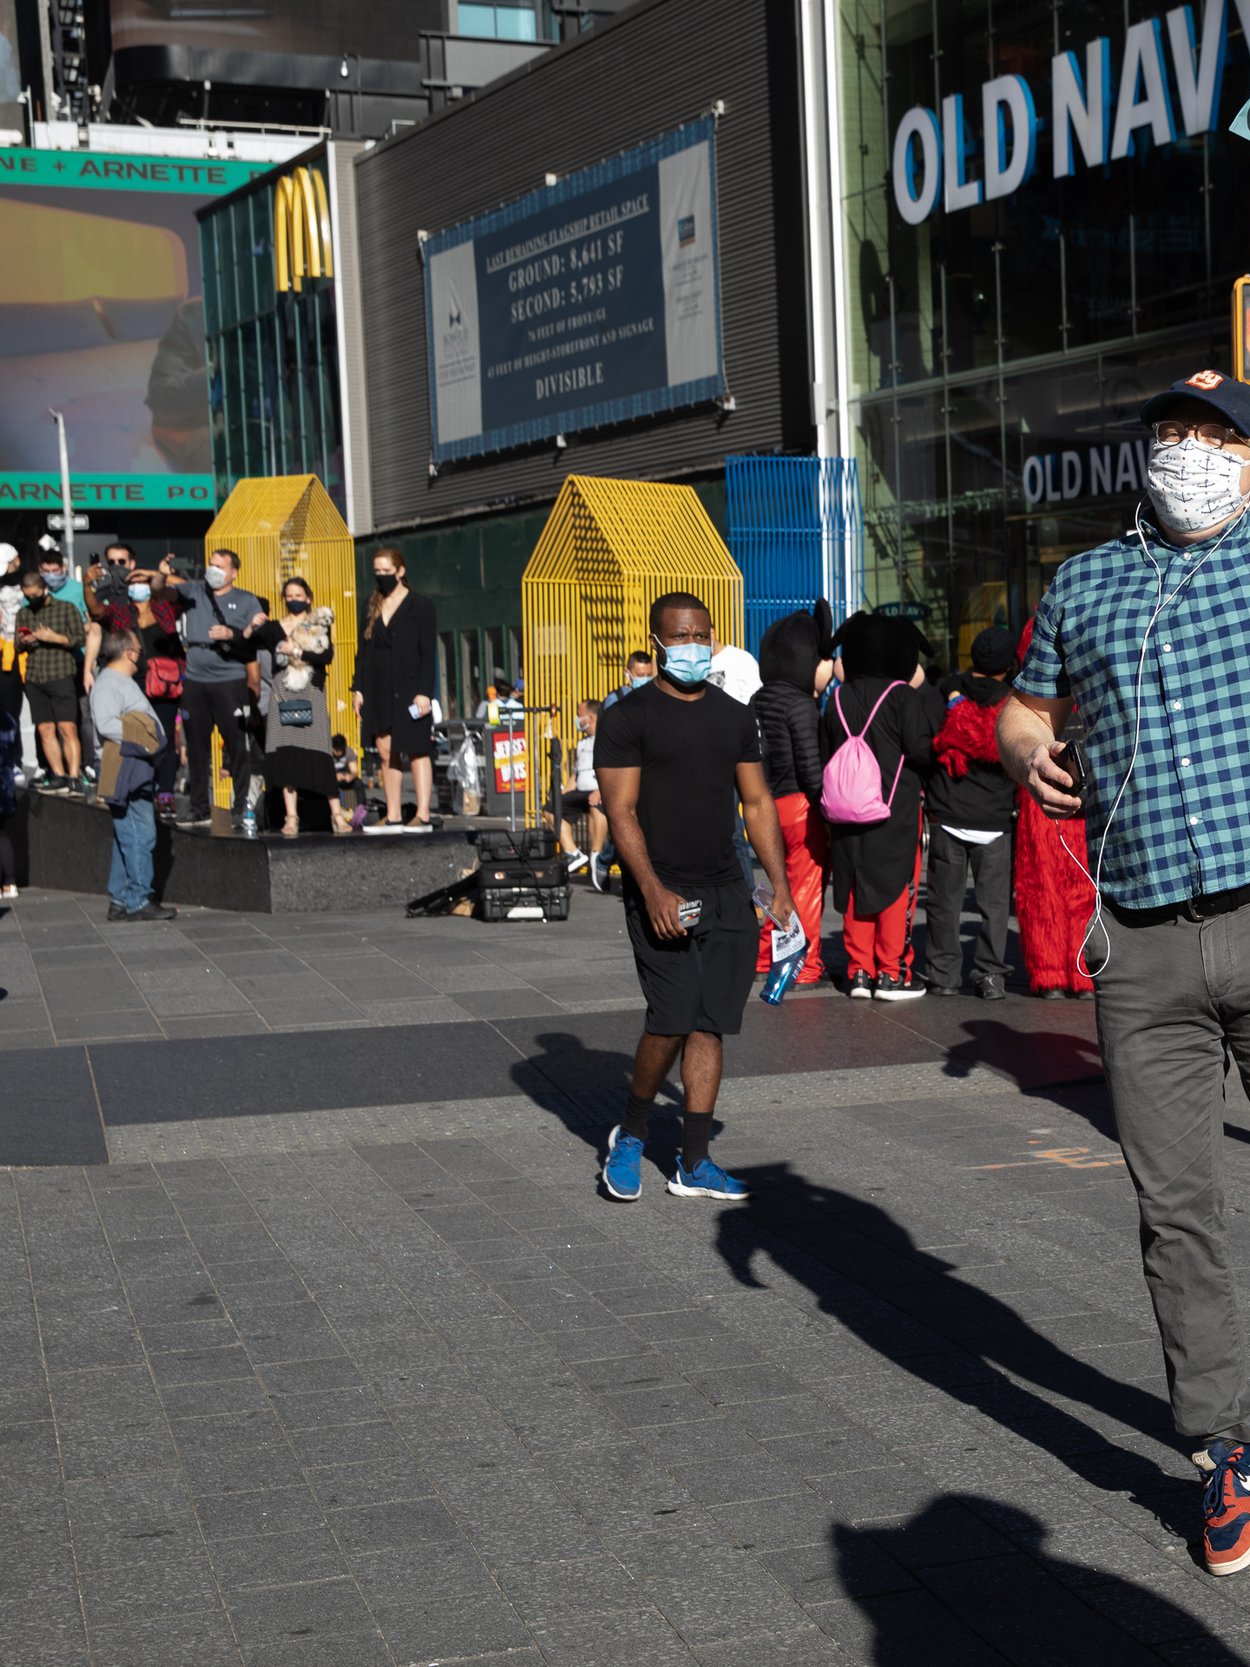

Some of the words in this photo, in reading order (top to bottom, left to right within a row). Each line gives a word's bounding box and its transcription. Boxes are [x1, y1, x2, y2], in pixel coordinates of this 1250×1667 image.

[79, 160, 227, 184] ARNETTE
[892, 74, 1037, 226] OLD
[486, 251, 504, 270] LAST
[505, 233, 549, 265] REMAINING
[549, 217, 588, 247] FLAGSHIP
[589, 206, 620, 231] RETAIL
[621, 194, 649, 219] SPACE
[508, 254, 566, 292] GROUND:
[569, 239, 603, 271] 8,641
[607, 230, 624, 256] SF
[511, 287, 566, 323] SECOND:
[570, 273, 603, 304] 5,793
[608, 265, 624, 290] SF
[537, 323, 555, 340] FEET
[556, 319, 566, 334] OF
[602, 328, 618, 346] AND
[618, 317, 654, 340] SIGNAGE
[535, 362, 604, 400] DIVISIBLE
[1023, 450, 1082, 504] OLD
